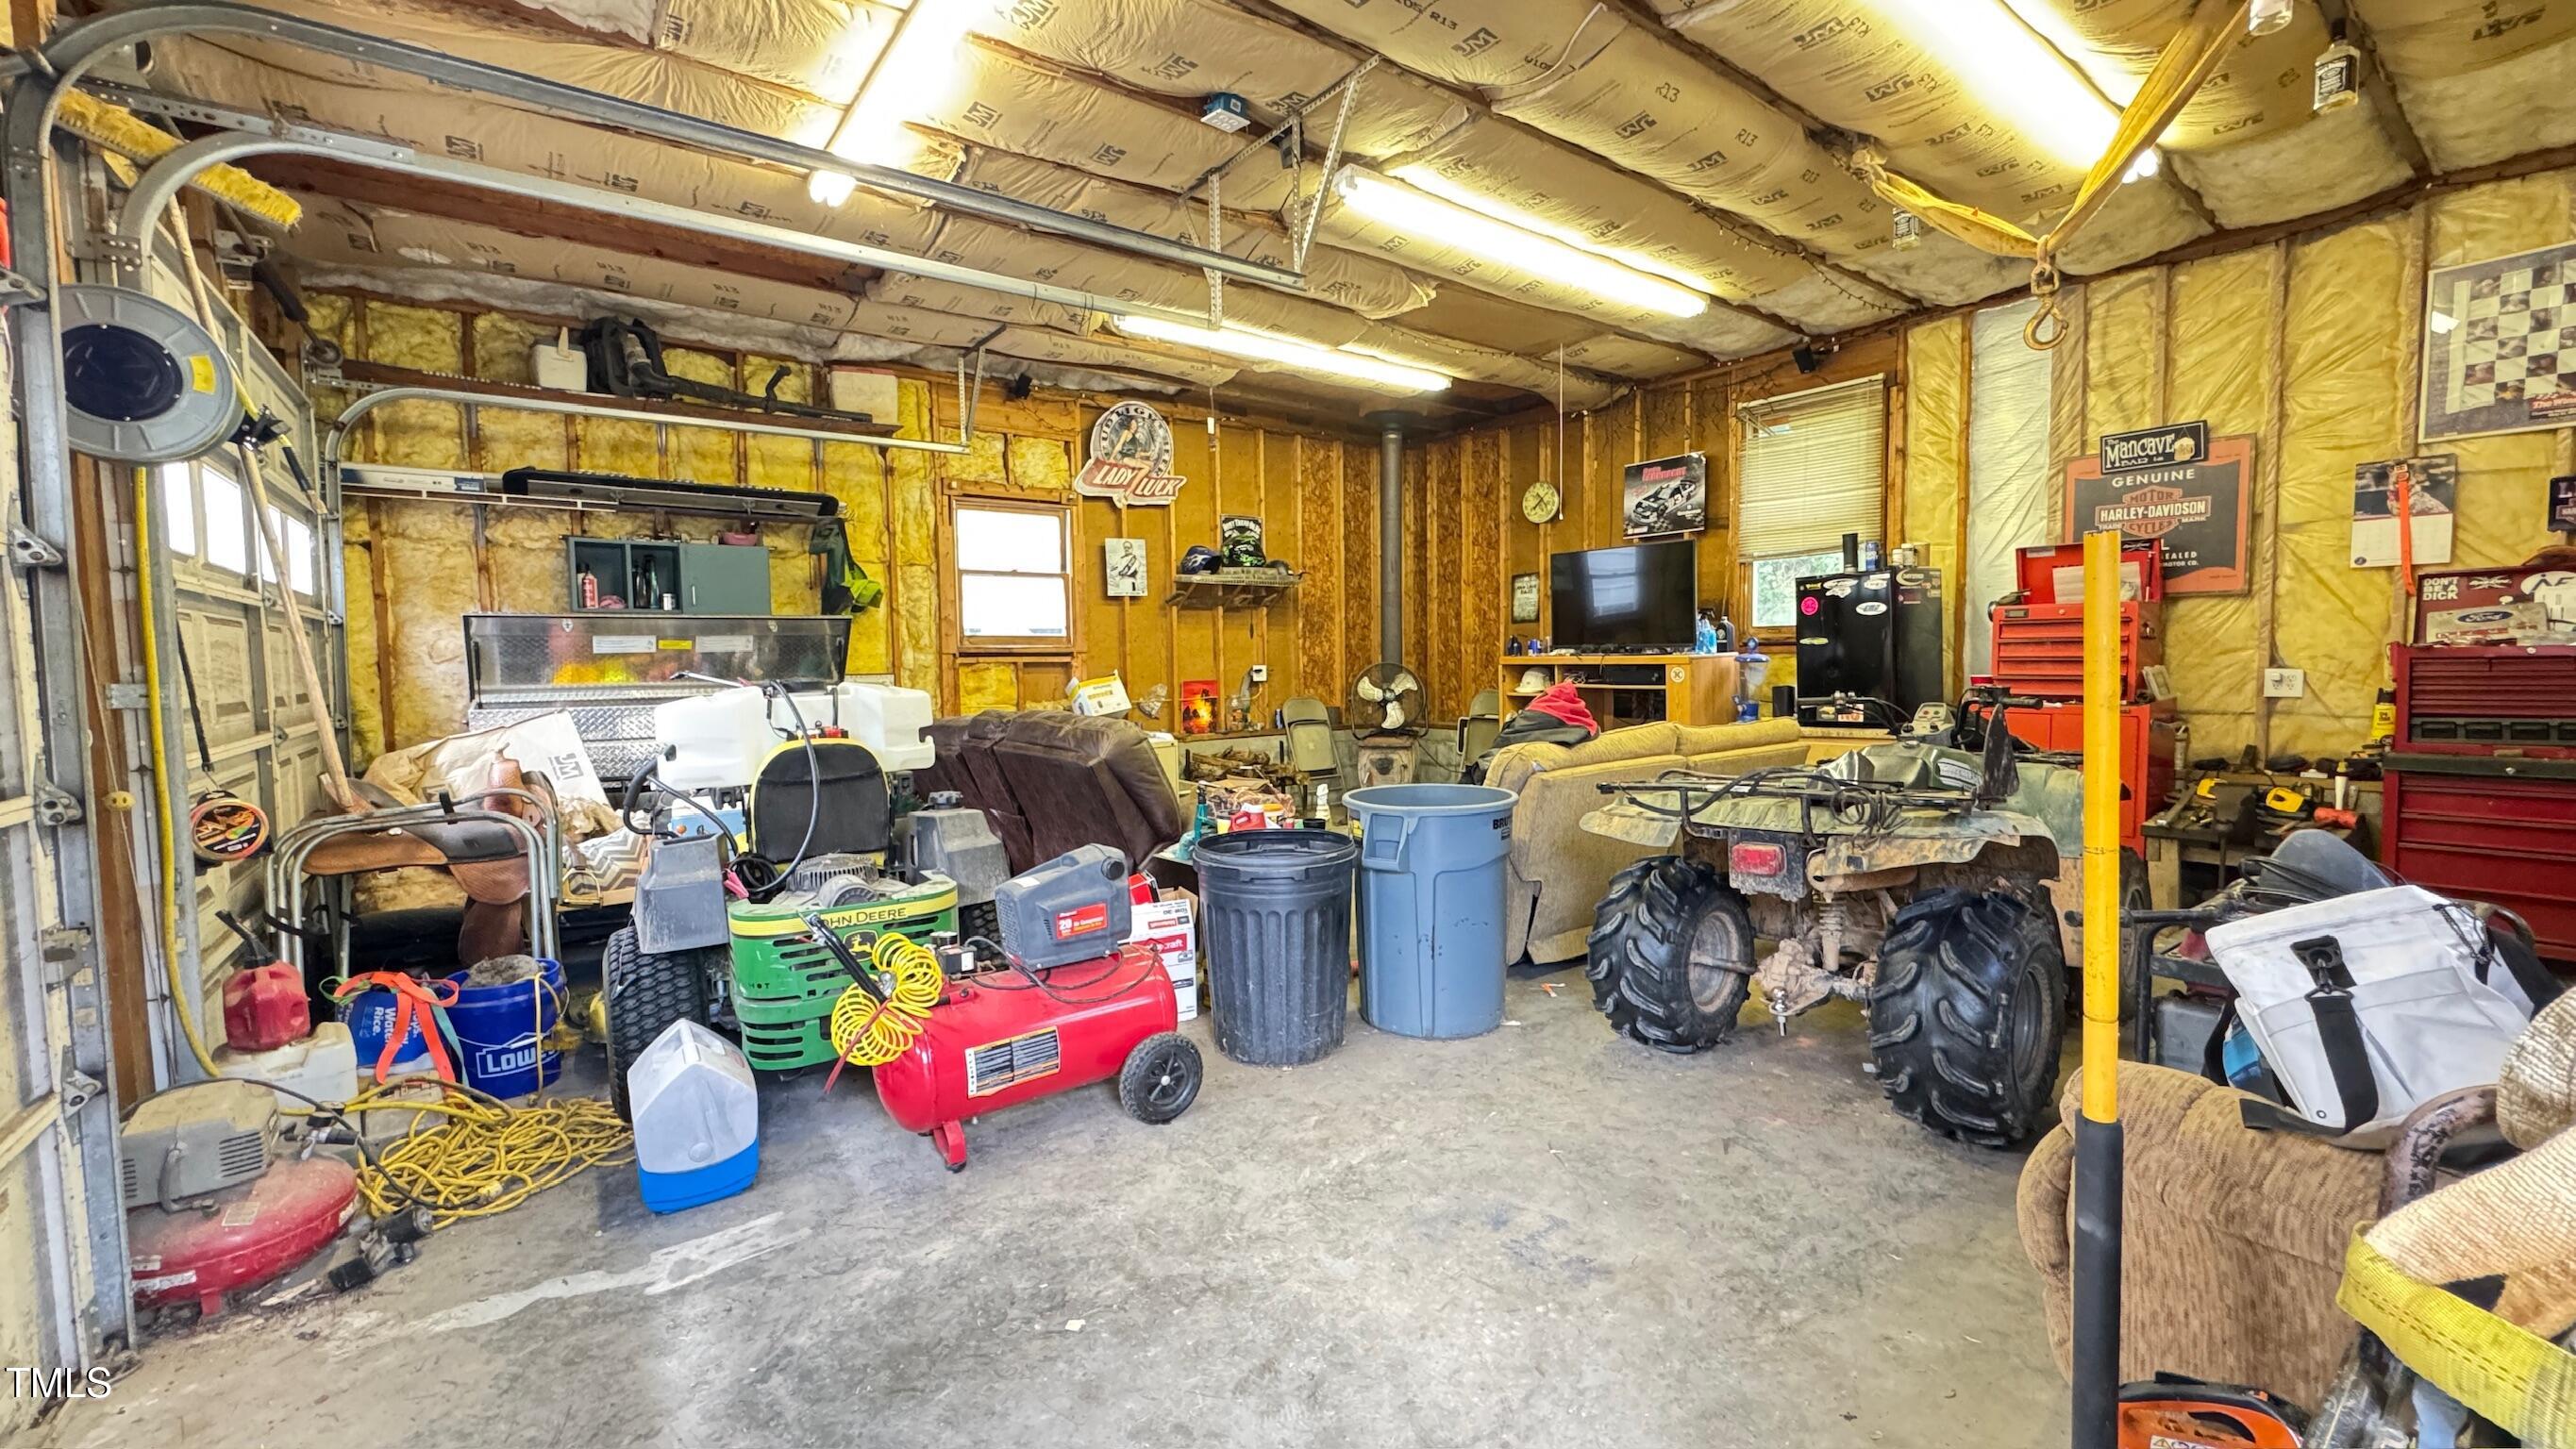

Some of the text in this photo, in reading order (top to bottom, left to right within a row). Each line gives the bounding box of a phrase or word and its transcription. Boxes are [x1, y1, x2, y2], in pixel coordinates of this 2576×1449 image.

[1430, 11, 1459, 30] R13
[1450, 27, 1498, 57] JM
[1655, 81, 1680, 103] R13
[963, 101, 997, 127] JM
[1735, 128, 1758, 147] R13
[1093, 465, 1180, 495] LADY LUCK
[2112, 469, 2196, 488] GENUINE
[2130, 489, 2174, 504] MOTOR
[2100, 501, 2206, 522] HARLEY-DAVIDSON
[2163, 551, 2197, 560] EALED
[2423, 576, 2459, 586] DON'T
[2447, 584, 2458, 592] A
[2422, 591, 2458, 601] DICK
[2465, 612, 2502, 624] Ford
[554, 753, 583, 780] JM
[857, 908, 907, 923] DEERE
[372, 1007, 384, 1036] Rice.
